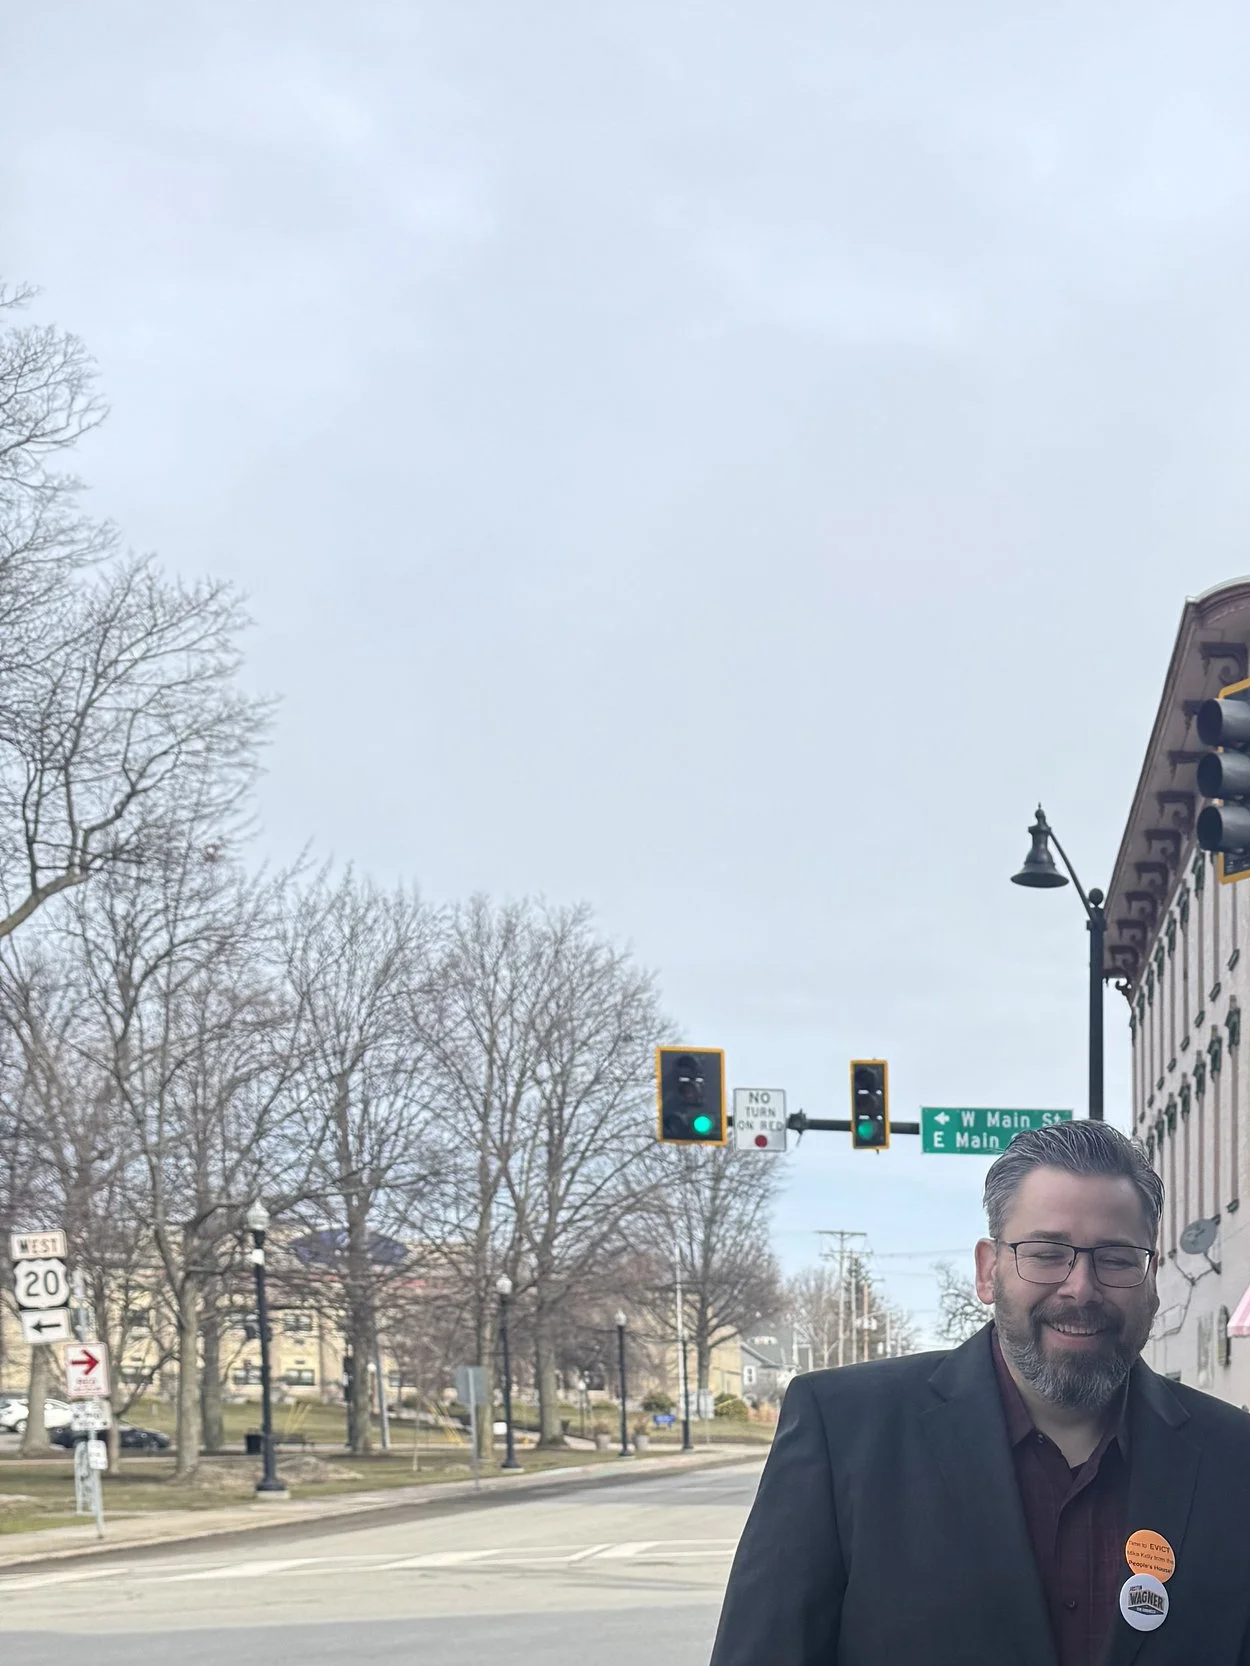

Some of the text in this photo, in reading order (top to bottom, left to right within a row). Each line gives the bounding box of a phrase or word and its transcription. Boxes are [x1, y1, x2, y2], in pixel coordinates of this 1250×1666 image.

[749, 1091, 771, 1104] NO
[745, 1106, 776, 1118] TURN
[961, 1111, 1063, 1128] W Main St
[737, 1120, 785, 1132] ON RED
[933, 1131, 945, 1148] E
[955, 1131, 1000, 1149] Main
[17, 1238, 58, 1254] WEST
[25, 1270, 59, 1297] 20
[1149, 1543, 1171, 1554] EVICT
[1129, 1590, 1165, 1612] WAGNER
